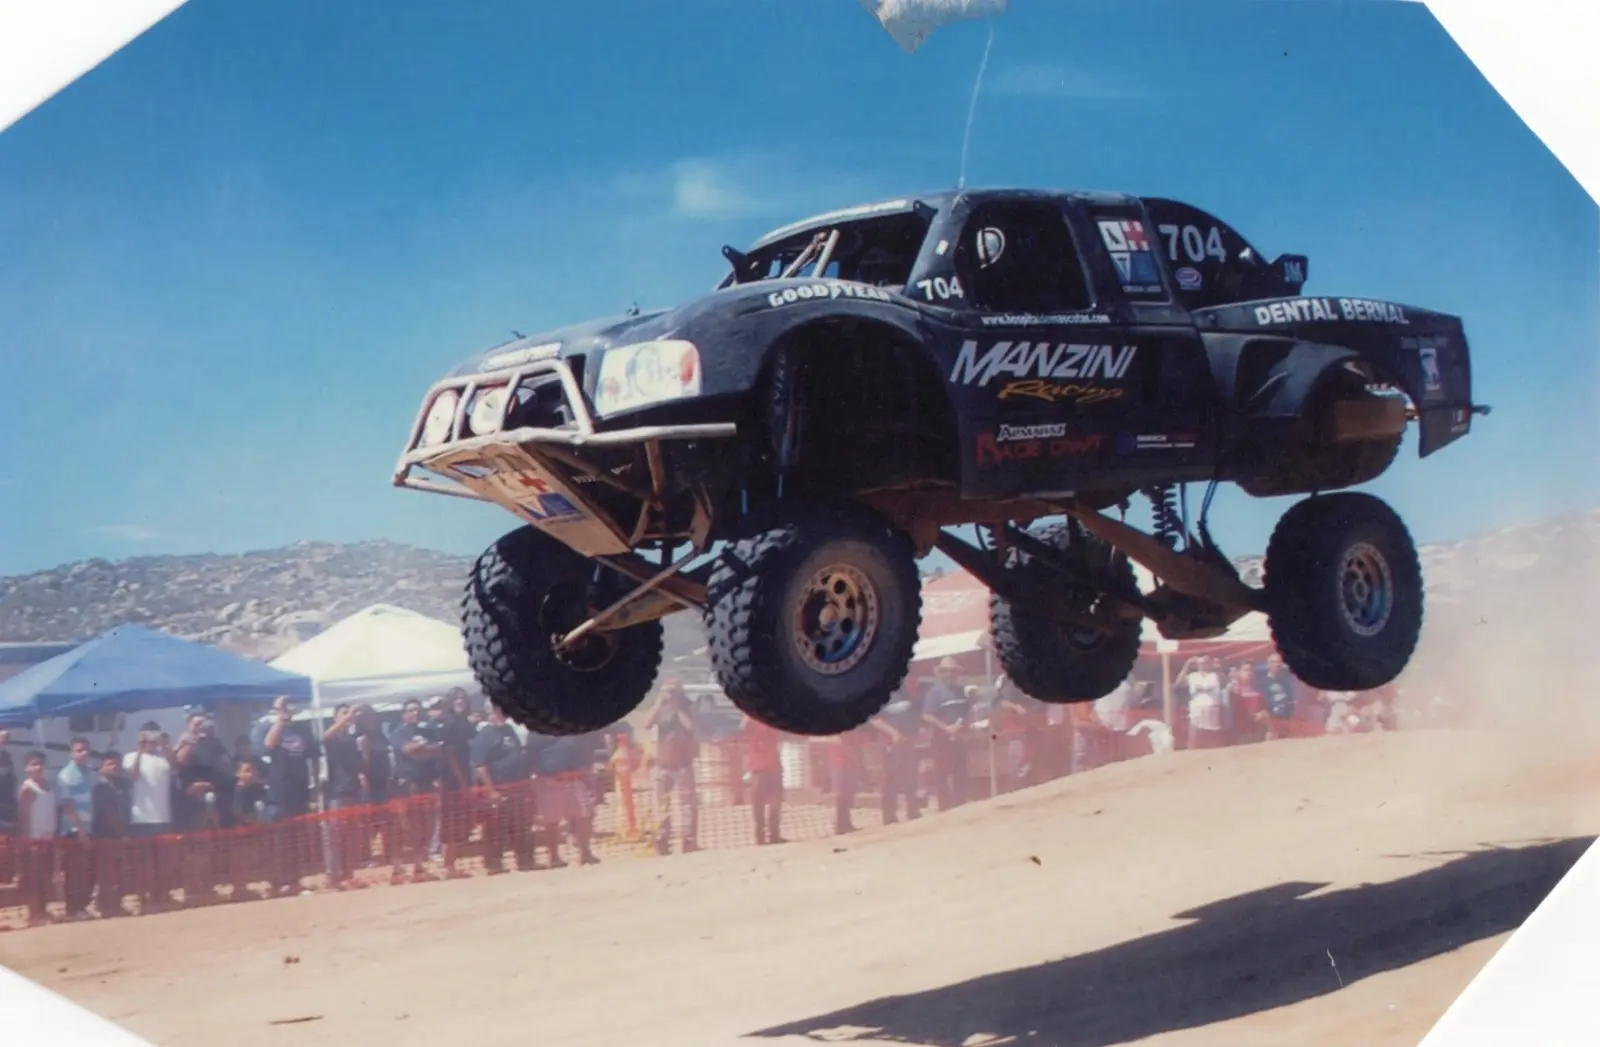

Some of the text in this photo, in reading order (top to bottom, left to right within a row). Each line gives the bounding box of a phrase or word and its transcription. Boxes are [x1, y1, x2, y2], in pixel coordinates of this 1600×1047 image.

[1159, 224, 1227, 263] 704
[768, 283, 891, 308] GOODYEAR
[917, 275, 964, 300] 704
[1253, 299, 1410, 325] DENTAL BERNAL
[950, 340, 1137, 387] MANZINI
